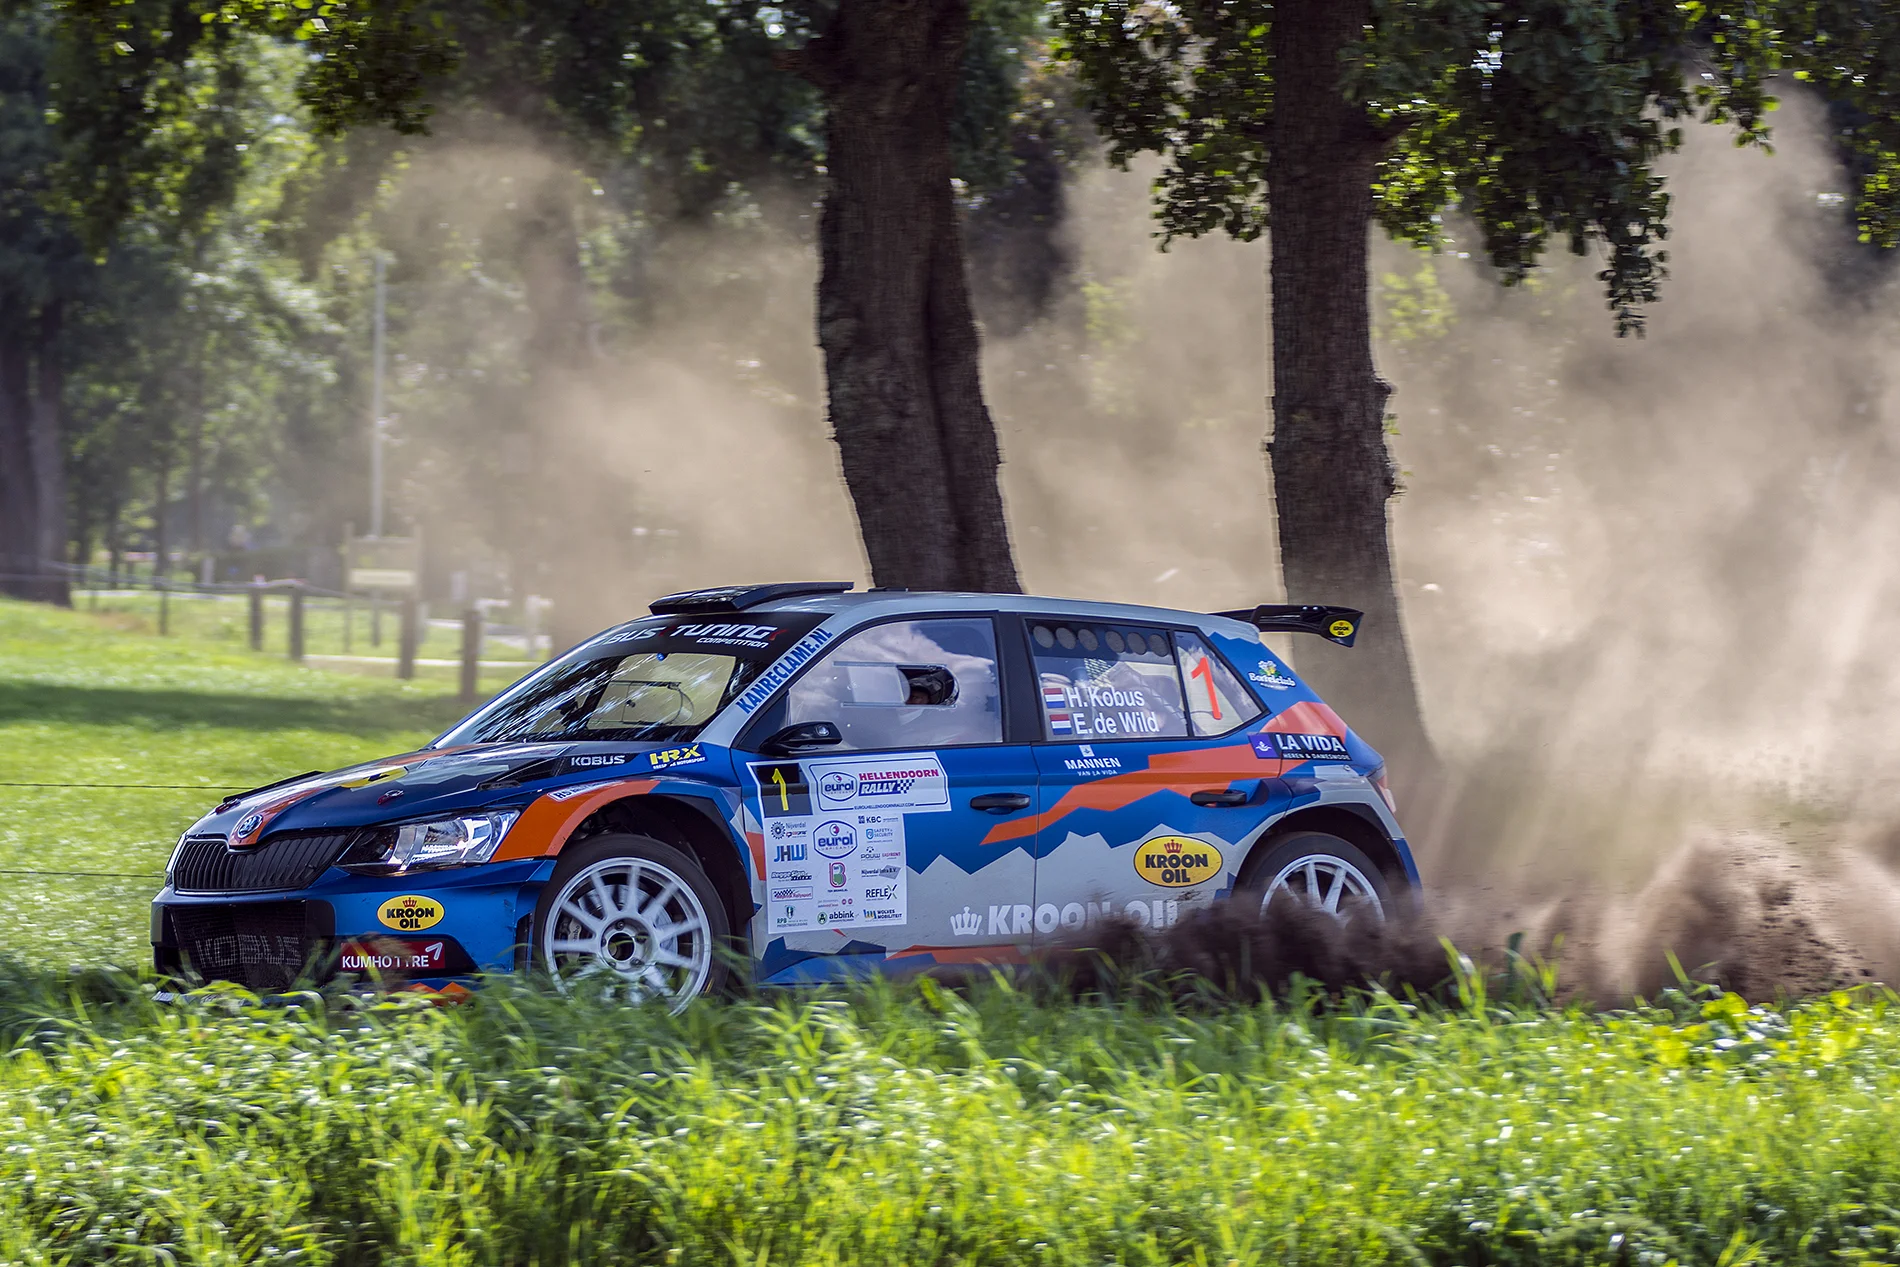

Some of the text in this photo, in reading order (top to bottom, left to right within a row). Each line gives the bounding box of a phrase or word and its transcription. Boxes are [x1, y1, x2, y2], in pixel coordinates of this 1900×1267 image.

[669, 623, 778, 639] TUNING
[695, 637, 769, 649] COMPETITION
[735, 627, 833, 715] KANRECLAME.NL
[1190, 656, 1223, 721] 1
[1065, 686, 1146, 708] H. Kobus
[1072, 711, 1160, 735] E. de Wild
[1275, 734, 1346, 752] LA VIDA
[571, 755, 625, 767] KOBUS
[649, 743, 701, 766] HRX
[1064, 757, 1122, 770] MANNEN
[858, 769, 939, 781] HELLENDOORN
[771, 768, 789, 811] 1
[824, 780, 854, 792] eurol
[860, 782, 896, 795] RALLY
[866, 815, 882, 824] KBC
[818, 833, 853, 847] eurol
[773, 844, 805, 863] JHW
[1145, 854, 1209, 868] KROON
[1161, 868, 1191, 883] OIL
[865, 884, 898, 900] REFLEX
[386, 907, 435, 919] KROON
[828, 910, 855, 919] abbink
[399, 918, 421, 929] OIL
[195, 932, 302, 968] KOBUS
[342, 955, 393, 968] KUMHO
